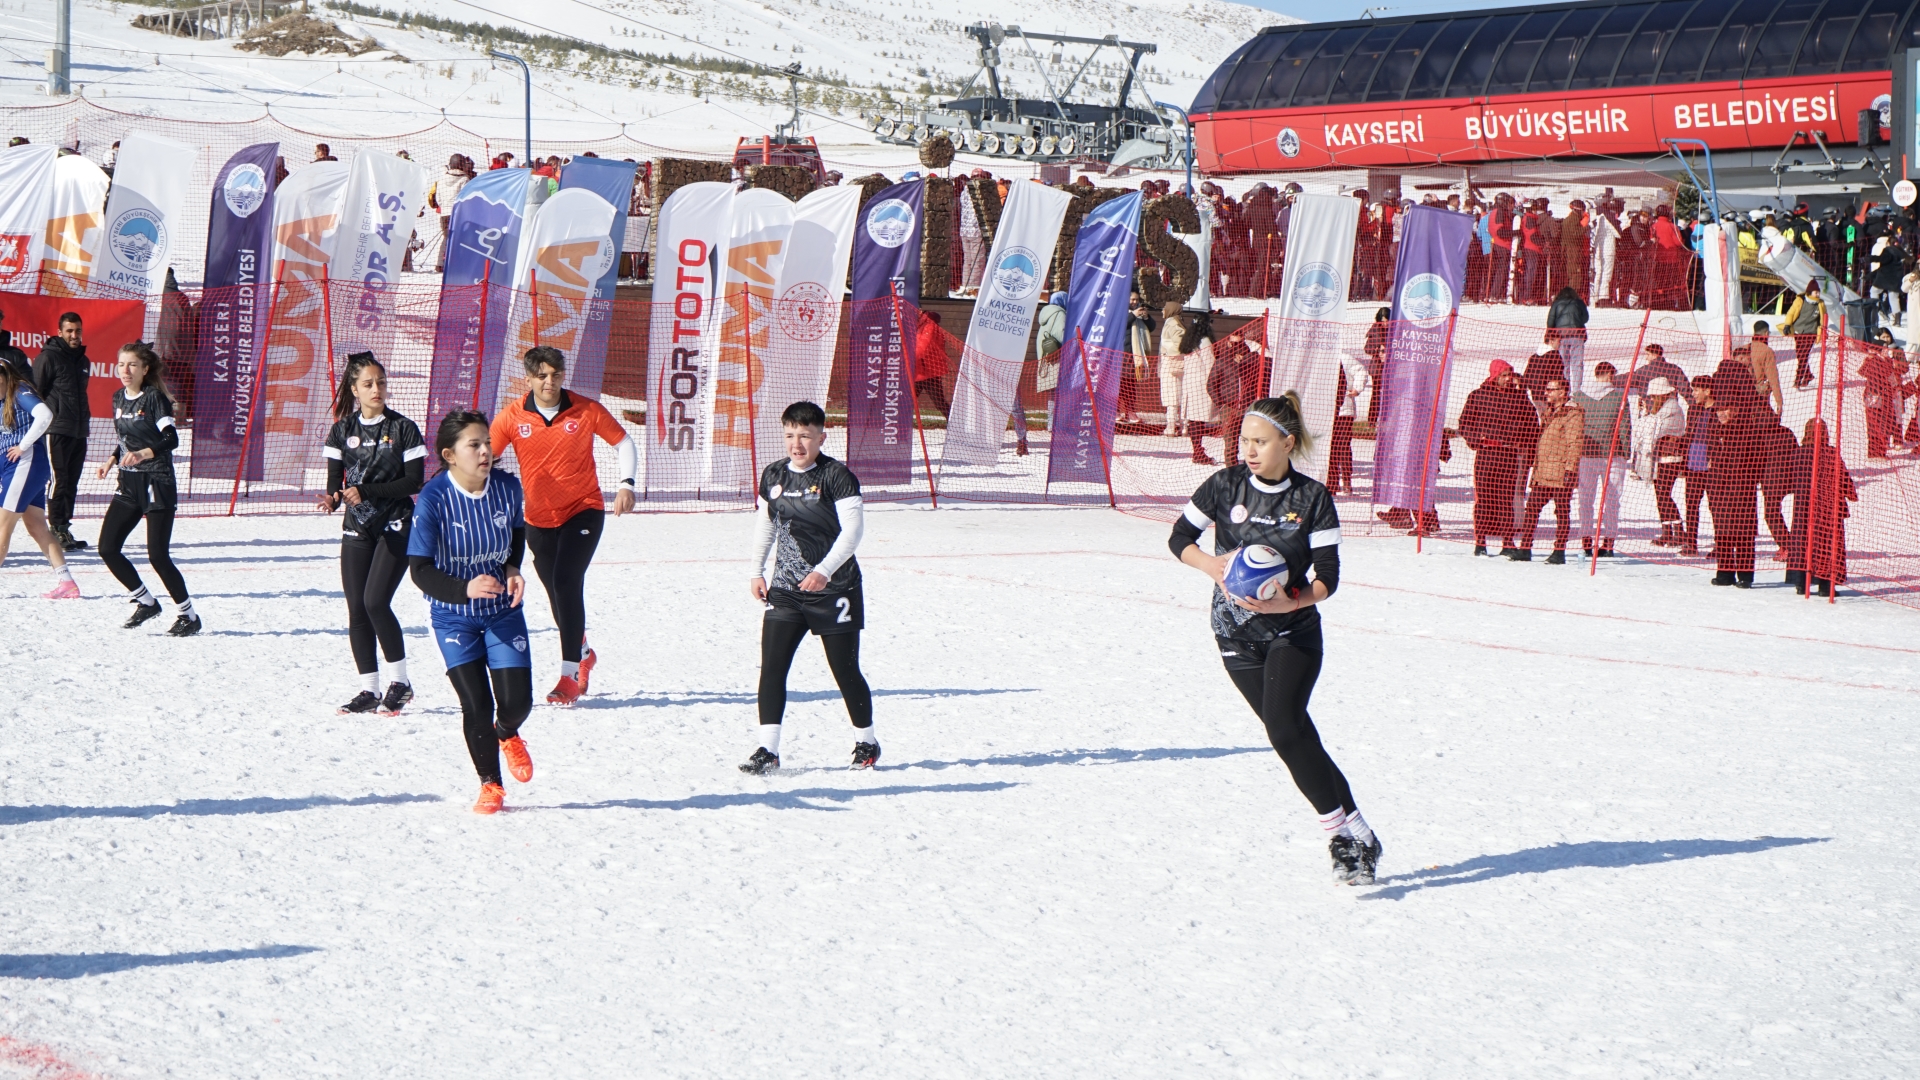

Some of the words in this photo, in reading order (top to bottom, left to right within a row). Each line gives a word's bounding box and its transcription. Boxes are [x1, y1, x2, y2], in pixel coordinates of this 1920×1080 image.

[1324, 114, 1424, 147] KAYSERİ
[1465, 103, 1629, 142] BÜYÜKŞEHİR
[1674, 89, 1837, 129] BELEDİYESİ
[109, 270, 153, 290] KAYSERİ
[127, 261, 143, 270] 1869
[355, 251, 387, 331] SPOR
[375, 190, 406, 246] A.Ş.
[235, 249, 256, 333] BELEDİYESİ
[978, 306, 1031, 328] BÜYÜKŞEHİR
[989, 299, 1026, 315] KAYSERİ
[213, 302, 230, 382] KAYSERİ
[265, 213, 337, 436] HUMA
[712, 239, 783, 449] HUMA
[978, 318, 1026, 338] BELEDİYESİ
[1402, 329, 1442, 343] KAYSERİ
[231, 338, 255, 436] BÜYÜKŞEHİR
[866, 326, 883, 399] KAYSERİ
[1394, 351, 1442, 365] BELEDİYES
[881, 357, 903, 445] BÜYÜKŞEHİR
[835, 597, 852, 624] 2
